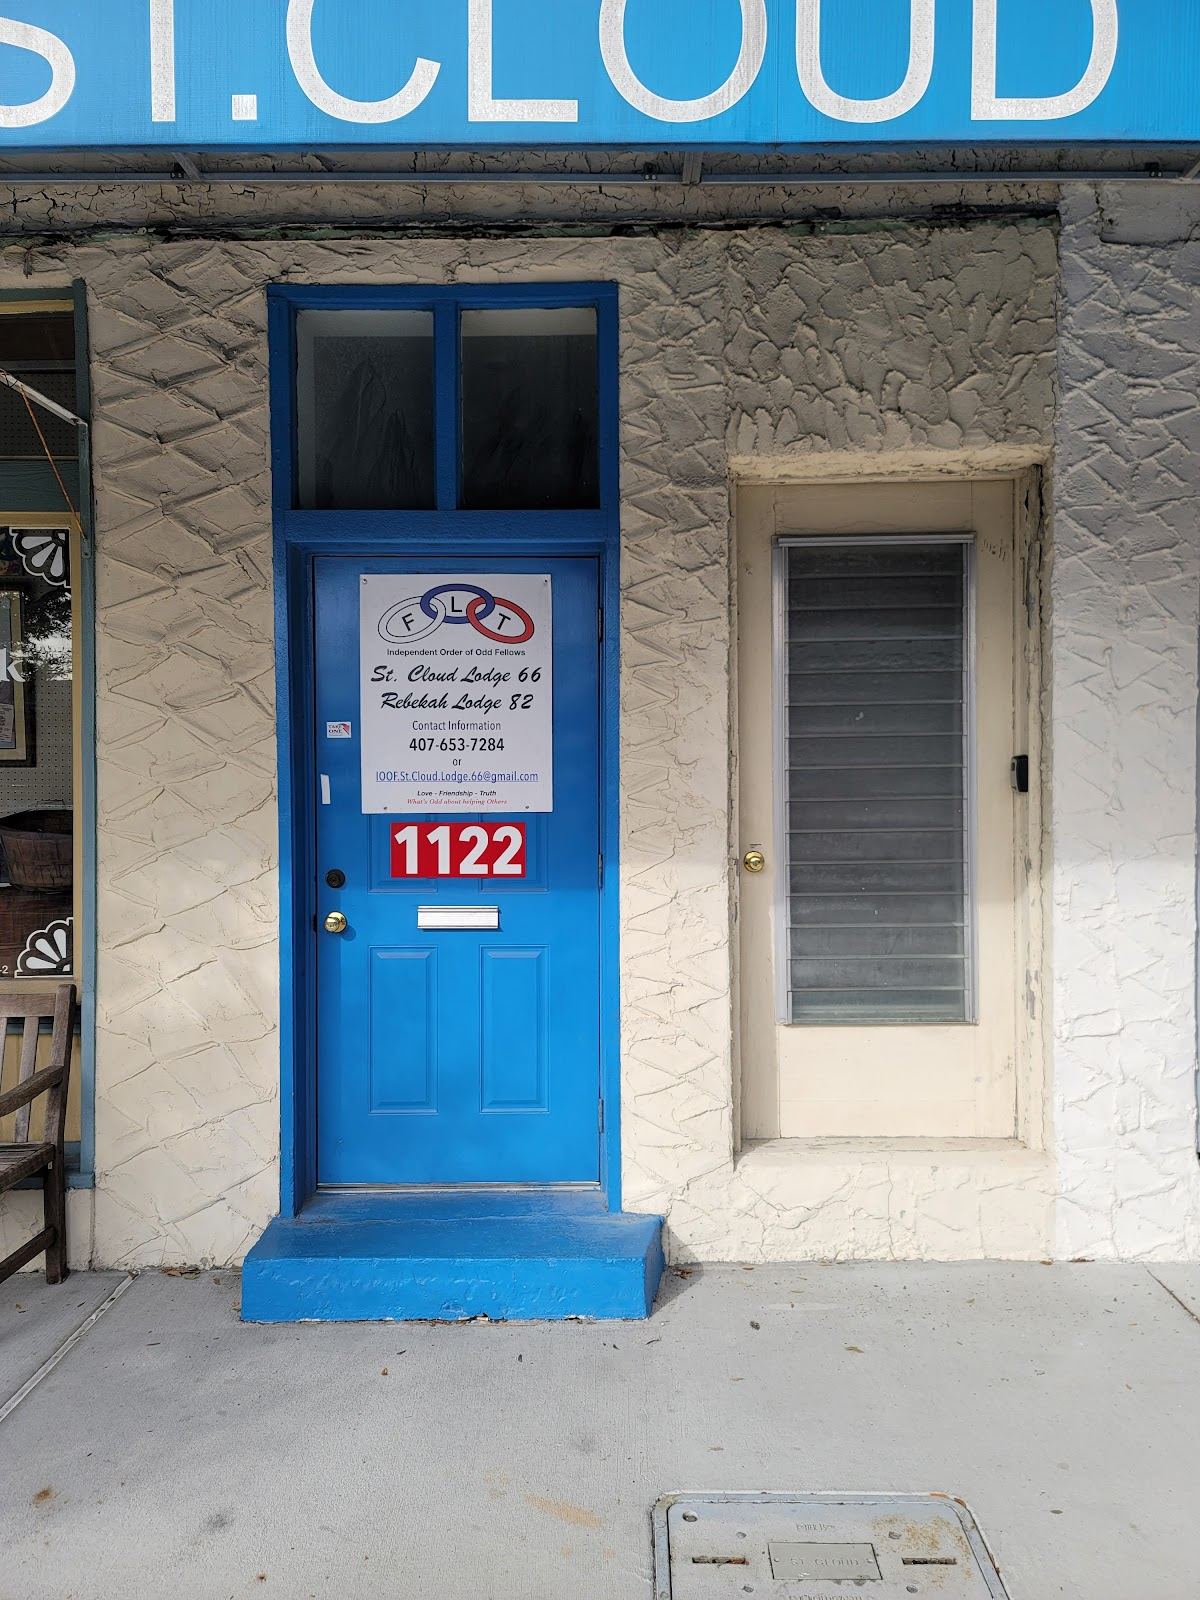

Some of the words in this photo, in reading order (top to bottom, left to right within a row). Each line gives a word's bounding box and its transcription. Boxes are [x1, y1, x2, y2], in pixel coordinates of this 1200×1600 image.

[401, 612, 415, 632] F
[450, 596, 463, 613] L
[497, 613, 511, 630] T
[386, 648, 438, 657] Independent
[439, 648, 463, 656] Order
[465, 648, 474, 656] of
[475, 648, 493, 656] Odd
[494, 648, 526, 656] Fellows
[370, 665, 398, 683] St.
[407, 664, 459, 683] Cloud
[460, 666, 511, 688] Lodge
[517, 666, 543, 683] 66
[380, 691, 449, 710] Rebekah
[450, 692, 503, 715] Lodge
[508, 693, 534, 711] 82
[412, 720, 447, 731] Contact
[448, 720, 502, 731] Information
[408, 737, 505, 752] 407-653-7284
[452, 758, 463, 767] or
[376, 770, 539, 784] IOOF.St.Cloud.Lodge.66@gmail.com
[438, 790, 474, 798] Friendship
[394, 825, 523, 875] 1122
